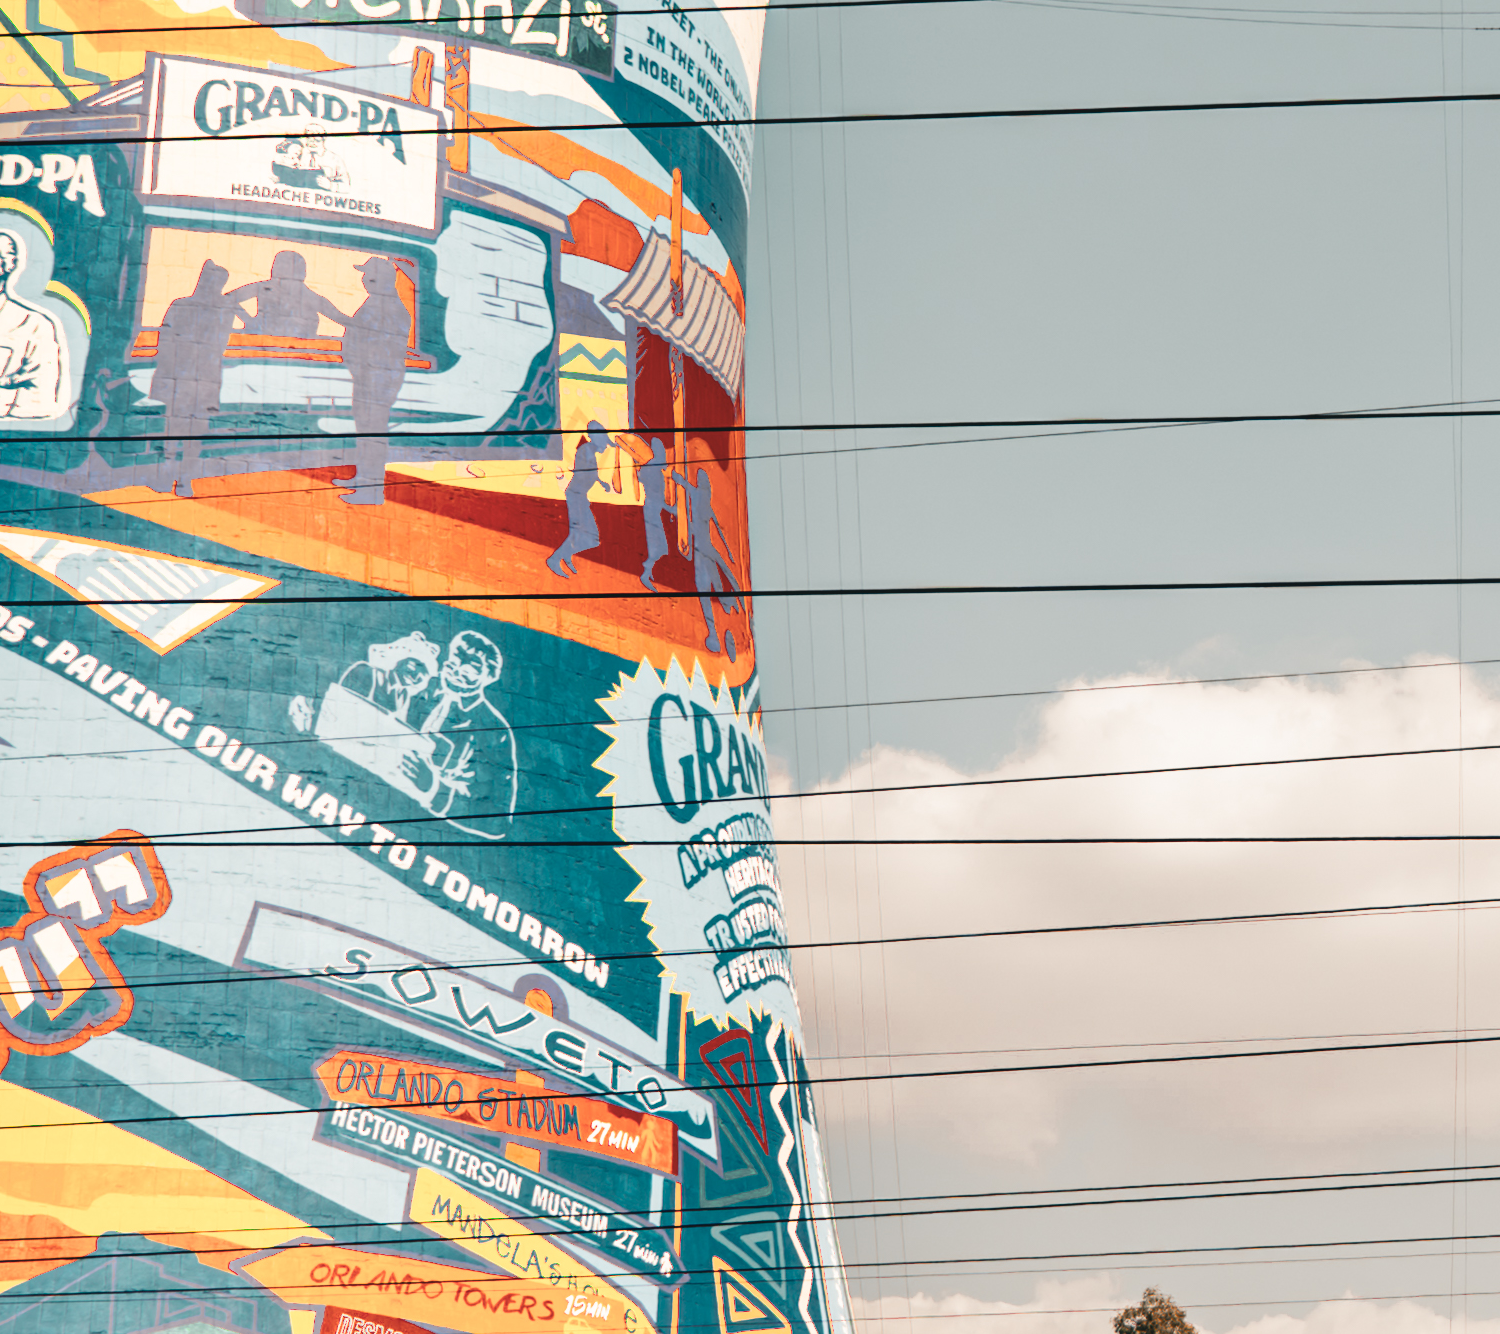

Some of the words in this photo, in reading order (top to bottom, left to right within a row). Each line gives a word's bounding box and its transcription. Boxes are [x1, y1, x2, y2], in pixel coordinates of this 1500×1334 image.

[623, 46, 635, 67] 2
[638, 53, 686, 100] NOBEL
[646, 24, 666, 54] IN
[194, 78, 407, 165] GRAND-PA
[230, 182, 311, 205] HEADACHE
[313, 193, 382, 216] POWDERS
[50, 638, 195, 742] PAVING
[197, 724, 279, 791] OUR
[281, 776, 368, 837] WAY
[369, 823, 418, 871] TO
[421, 860, 610, 988] TOMORROW
[325, 948, 668, 1111] SOWETO
[336, 1058, 464, 1114] ORLANDO
[477, 1086, 582, 1141] STADIUM
[331, 1102, 411, 1149] HECTOR
[411, 1122, 523, 1199] PIETERSON
[531, 1185, 609, 1239] MUSEUM
[453, 1282, 556, 1322] TOWERS
